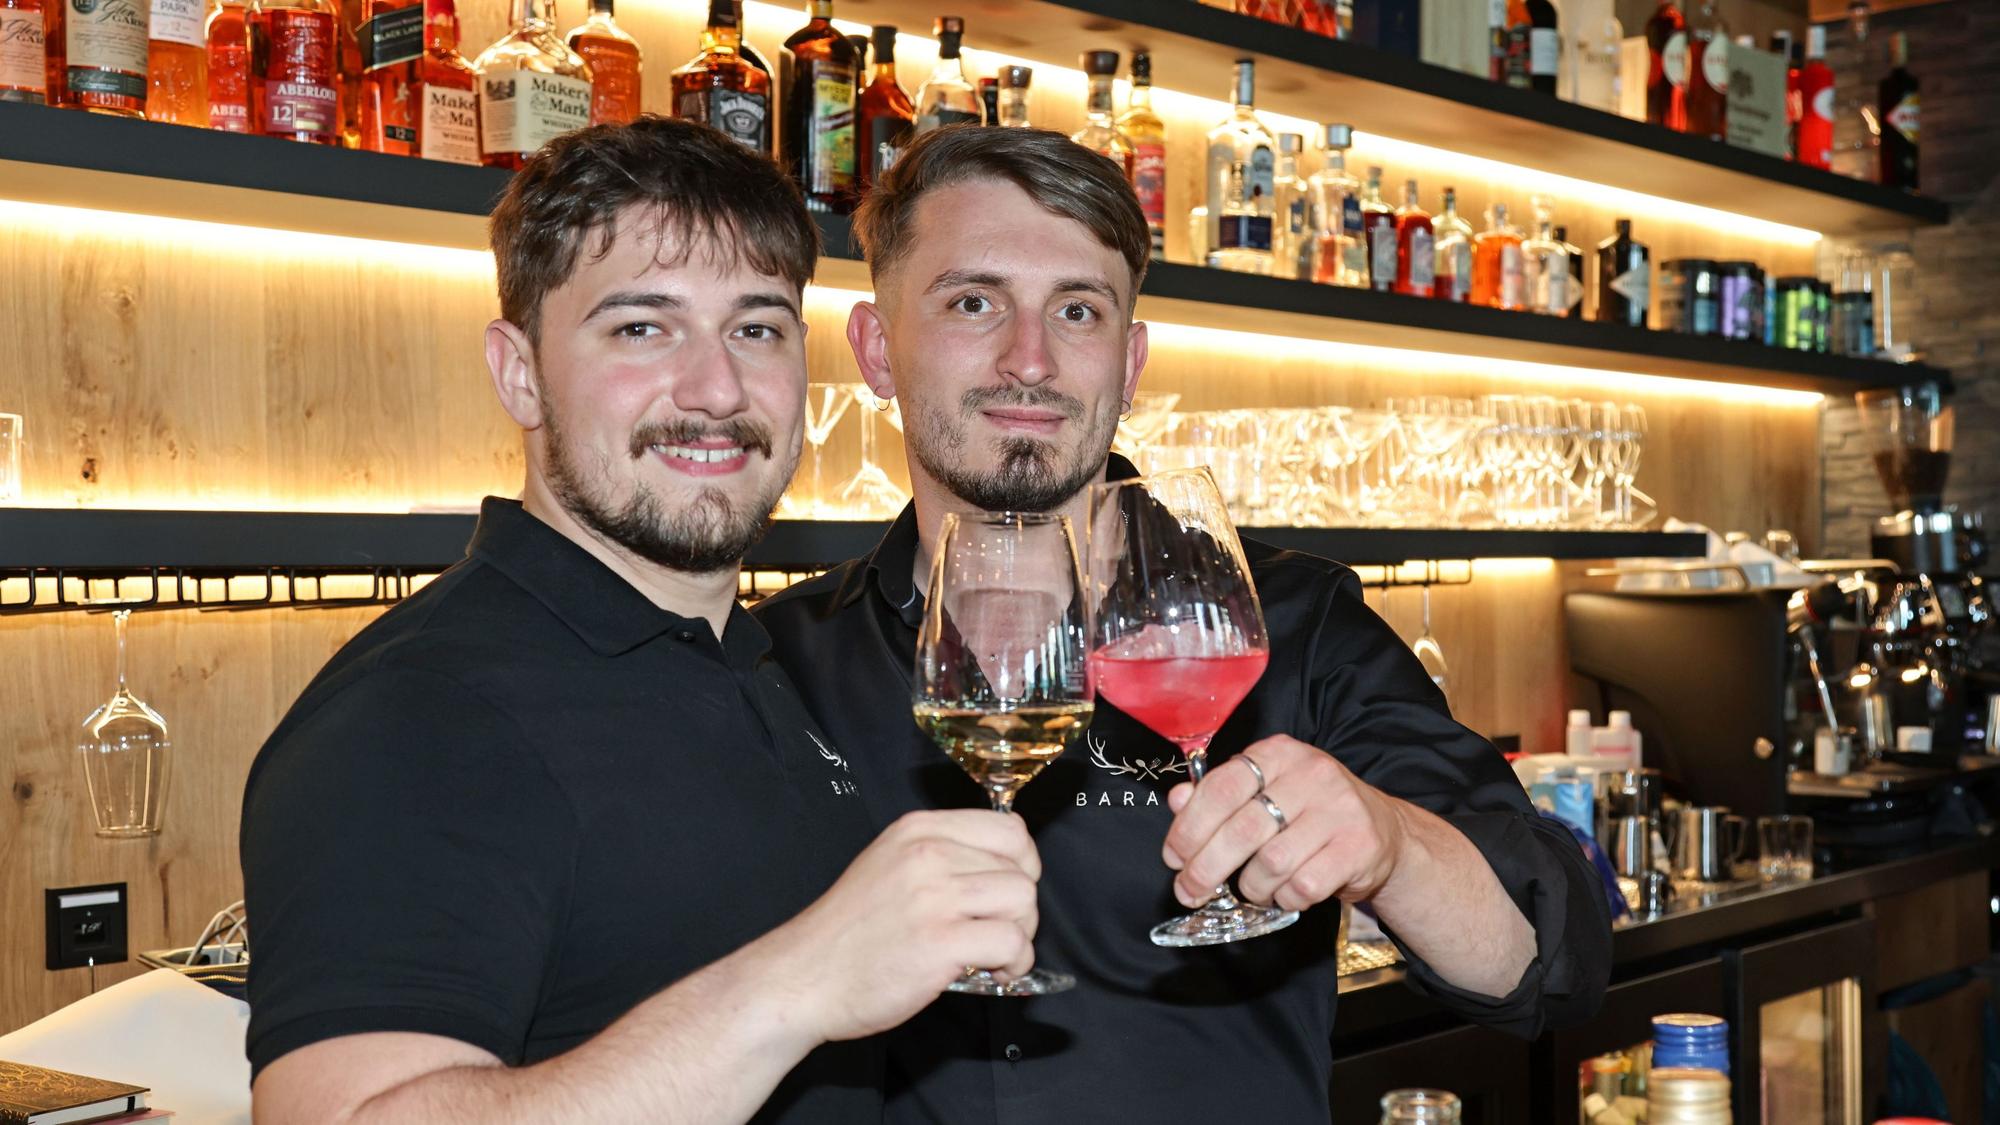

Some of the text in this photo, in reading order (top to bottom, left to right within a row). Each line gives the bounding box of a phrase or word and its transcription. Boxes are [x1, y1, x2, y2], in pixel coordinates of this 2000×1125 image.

[530, 77, 589, 101] Maker's
[271, 104, 293, 122] 12
[548, 97, 589, 119] Mark
[1075, 790, 1160, 807] BARA
